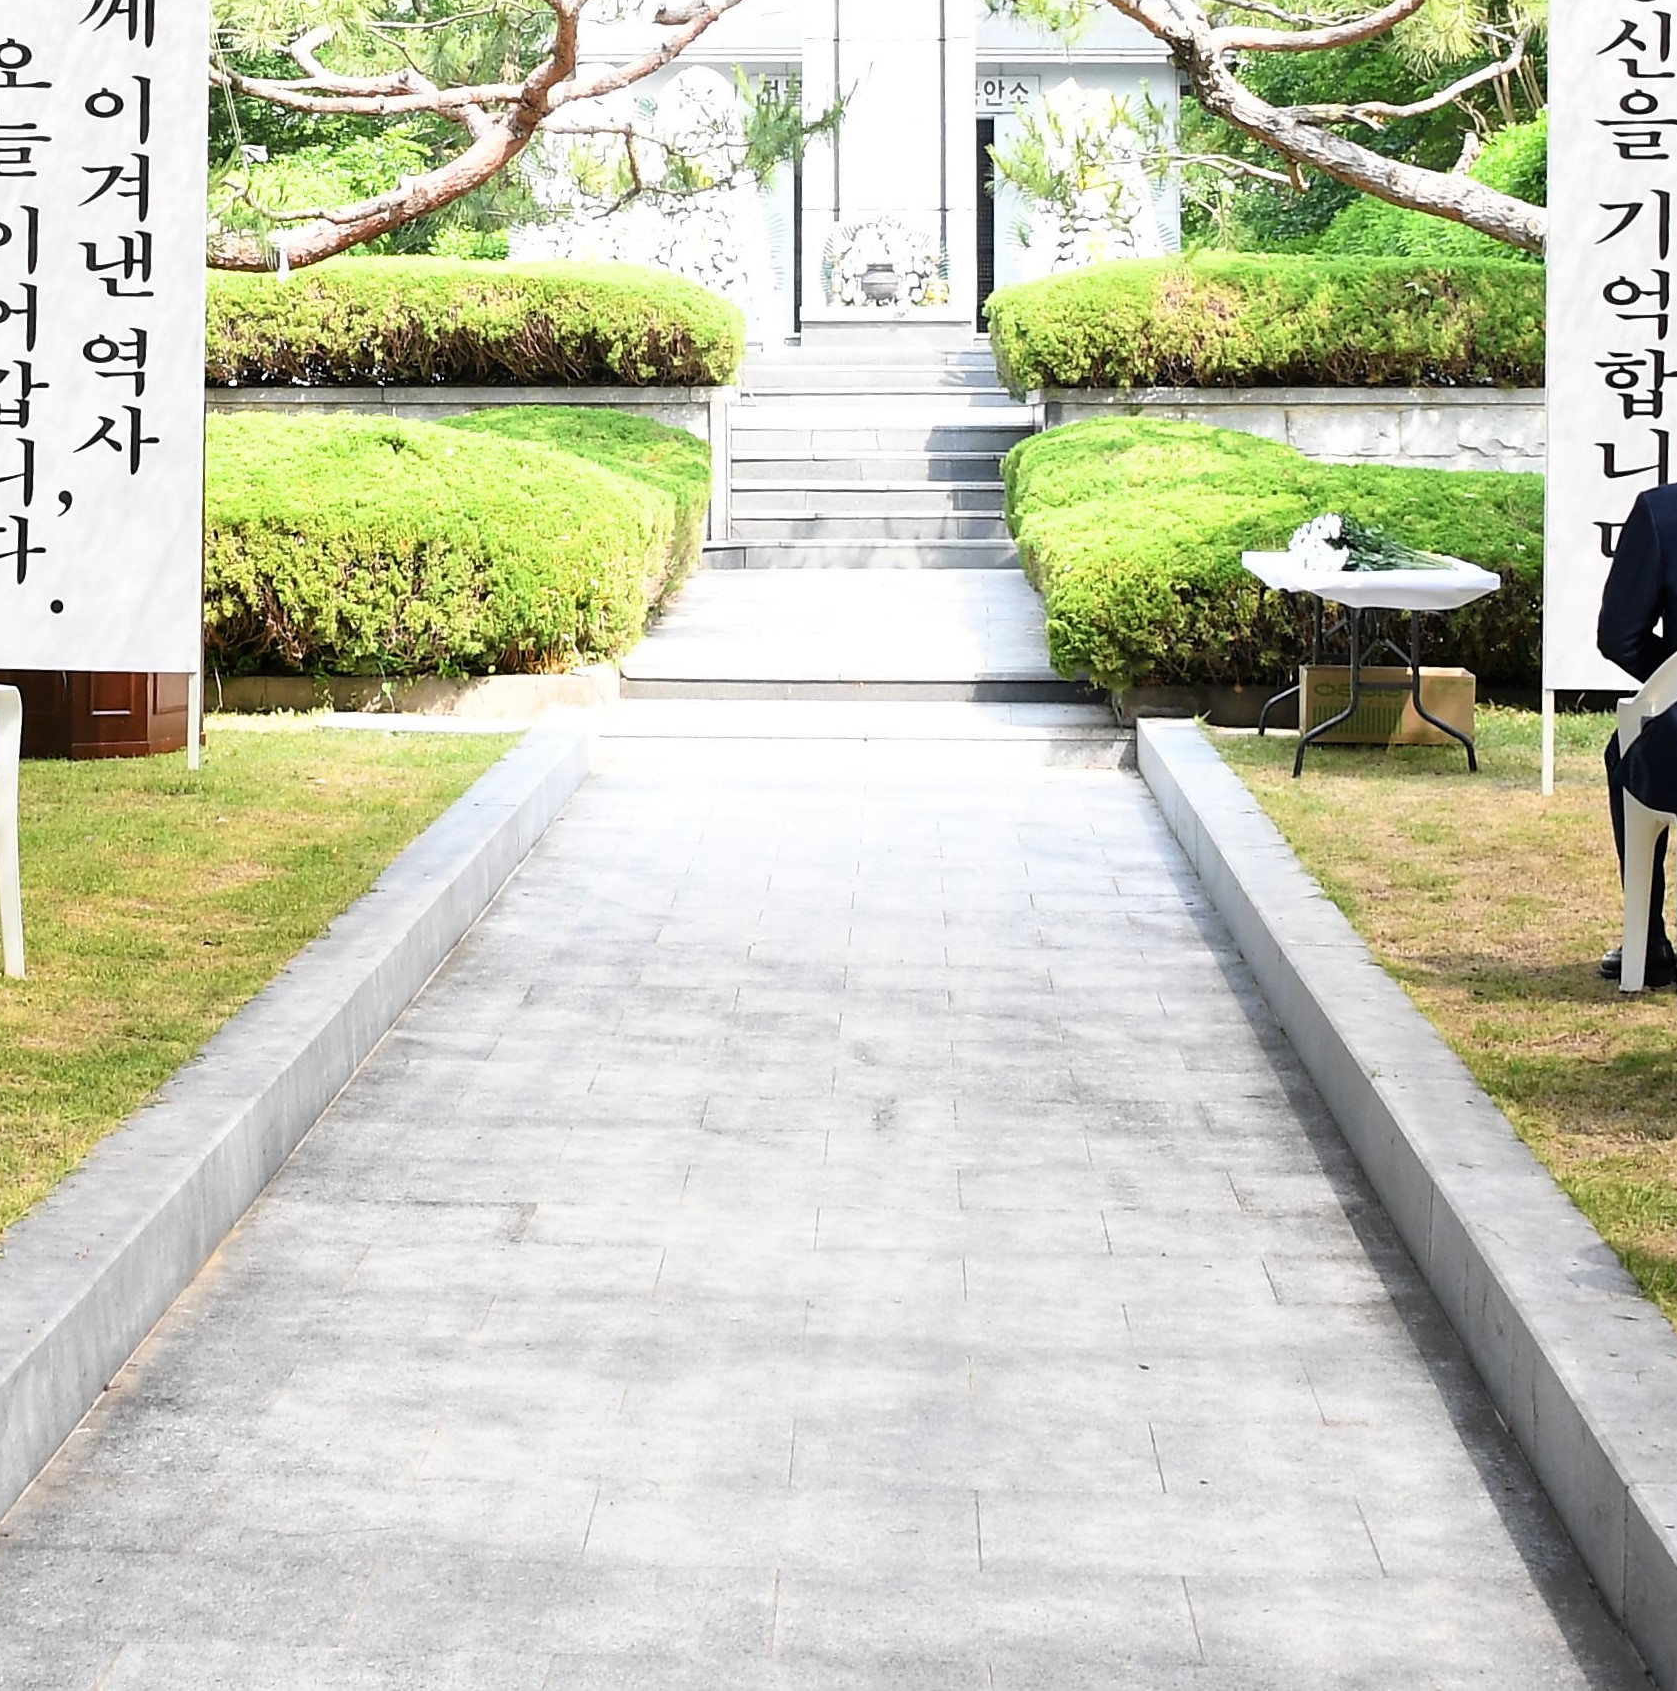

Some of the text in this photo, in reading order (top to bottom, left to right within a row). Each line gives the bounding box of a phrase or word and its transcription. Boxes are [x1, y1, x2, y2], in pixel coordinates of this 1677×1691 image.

[76, 75, 155, 298] 이겨낸
[975, 78, 1029, 106] 안소
[57, 326, 161, 519] 역사,
